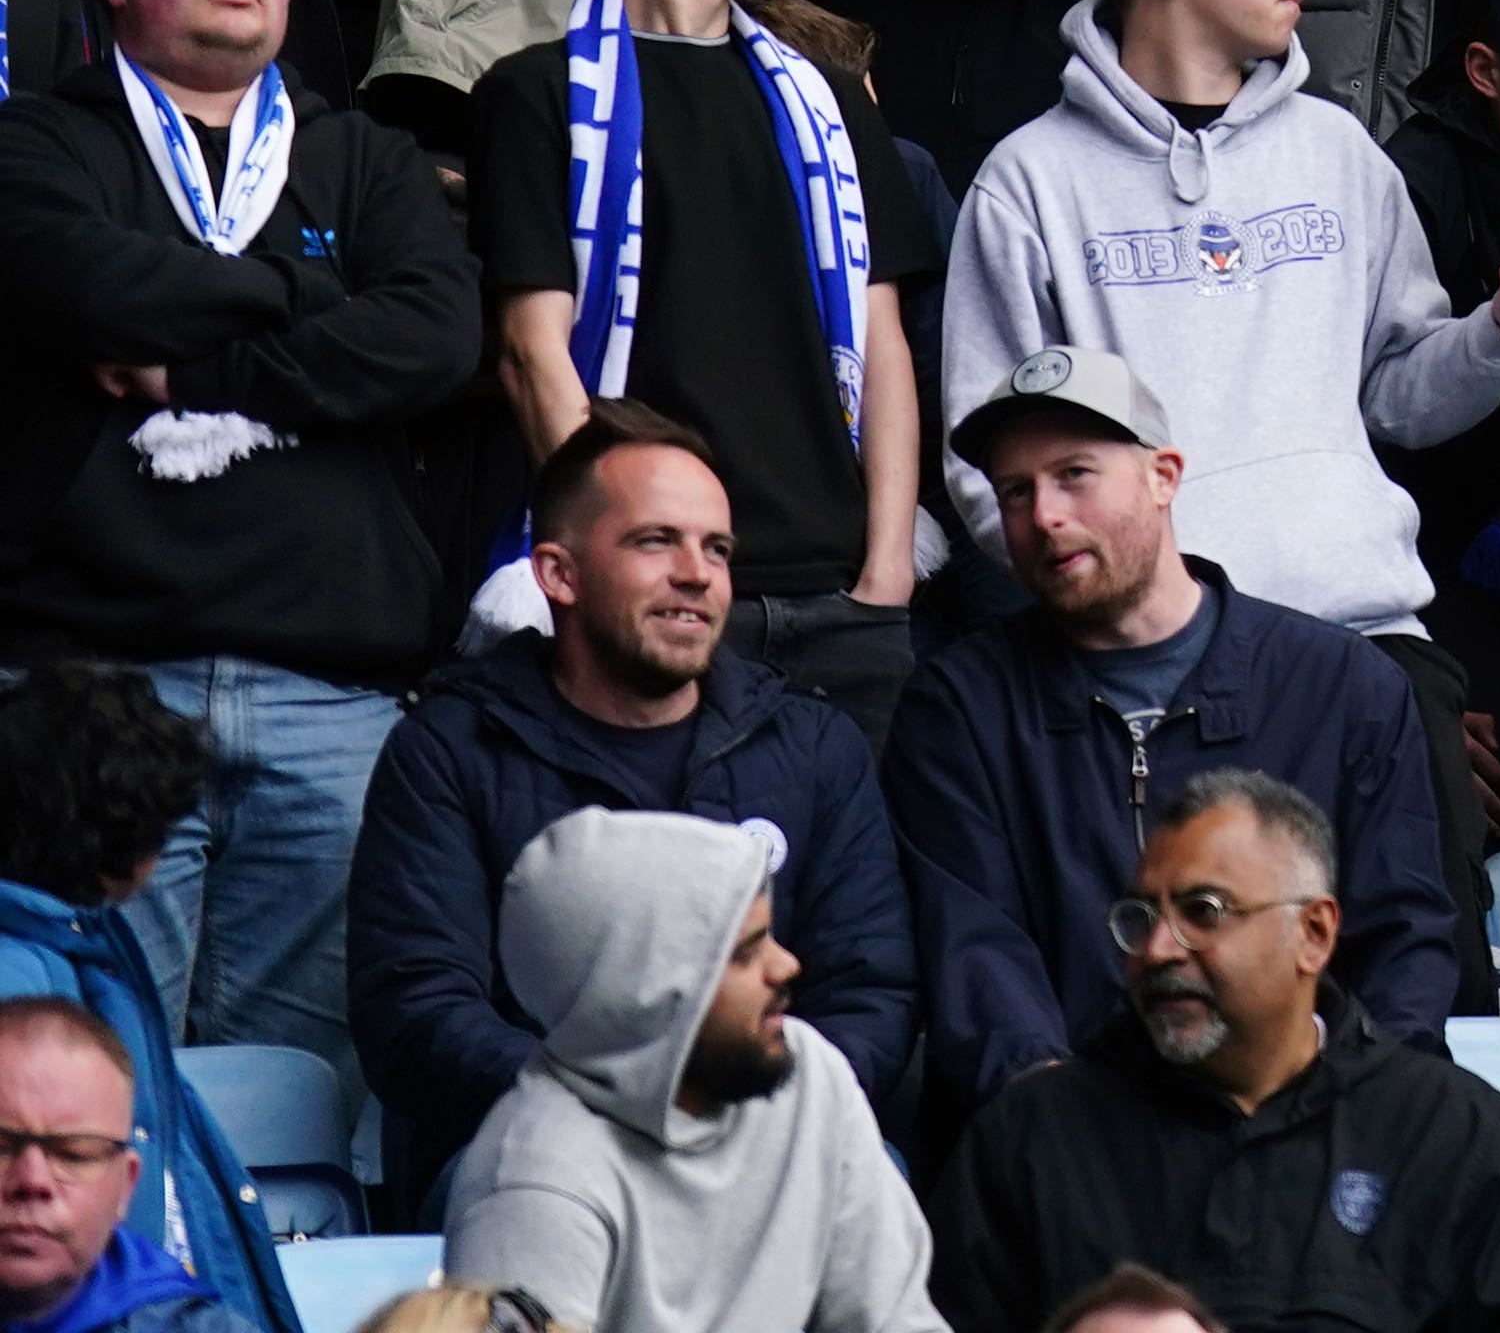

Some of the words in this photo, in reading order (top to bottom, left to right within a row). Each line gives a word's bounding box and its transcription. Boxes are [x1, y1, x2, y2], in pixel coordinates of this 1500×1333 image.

[813, 105, 869, 272] CITY
[1083, 235, 1179, 285] 2013
[1257, 209, 1346, 263] 2023
